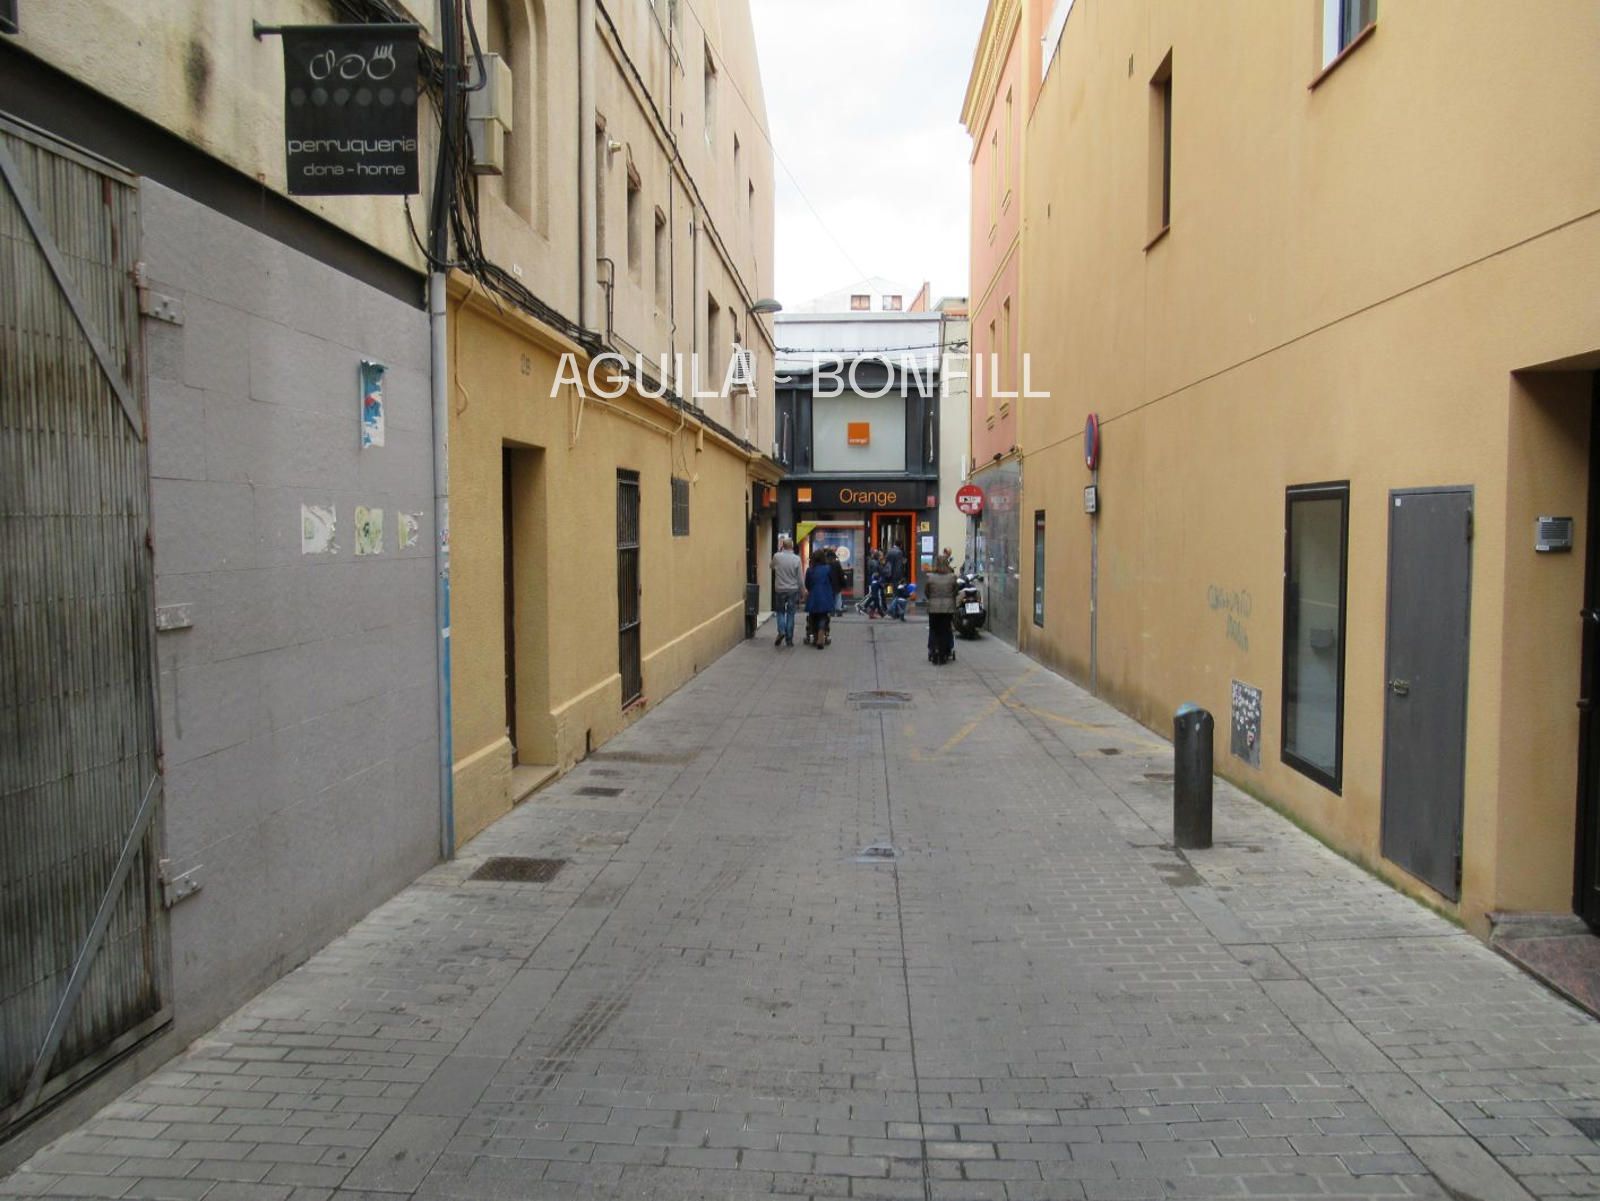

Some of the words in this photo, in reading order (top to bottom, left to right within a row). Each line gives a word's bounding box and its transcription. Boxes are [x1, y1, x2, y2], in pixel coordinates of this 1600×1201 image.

[288, 136, 416, 155] perruqueria
[303, 162, 344, 176] dona
[357, 162, 405, 176] home
[839, 488, 897, 507] Orange
